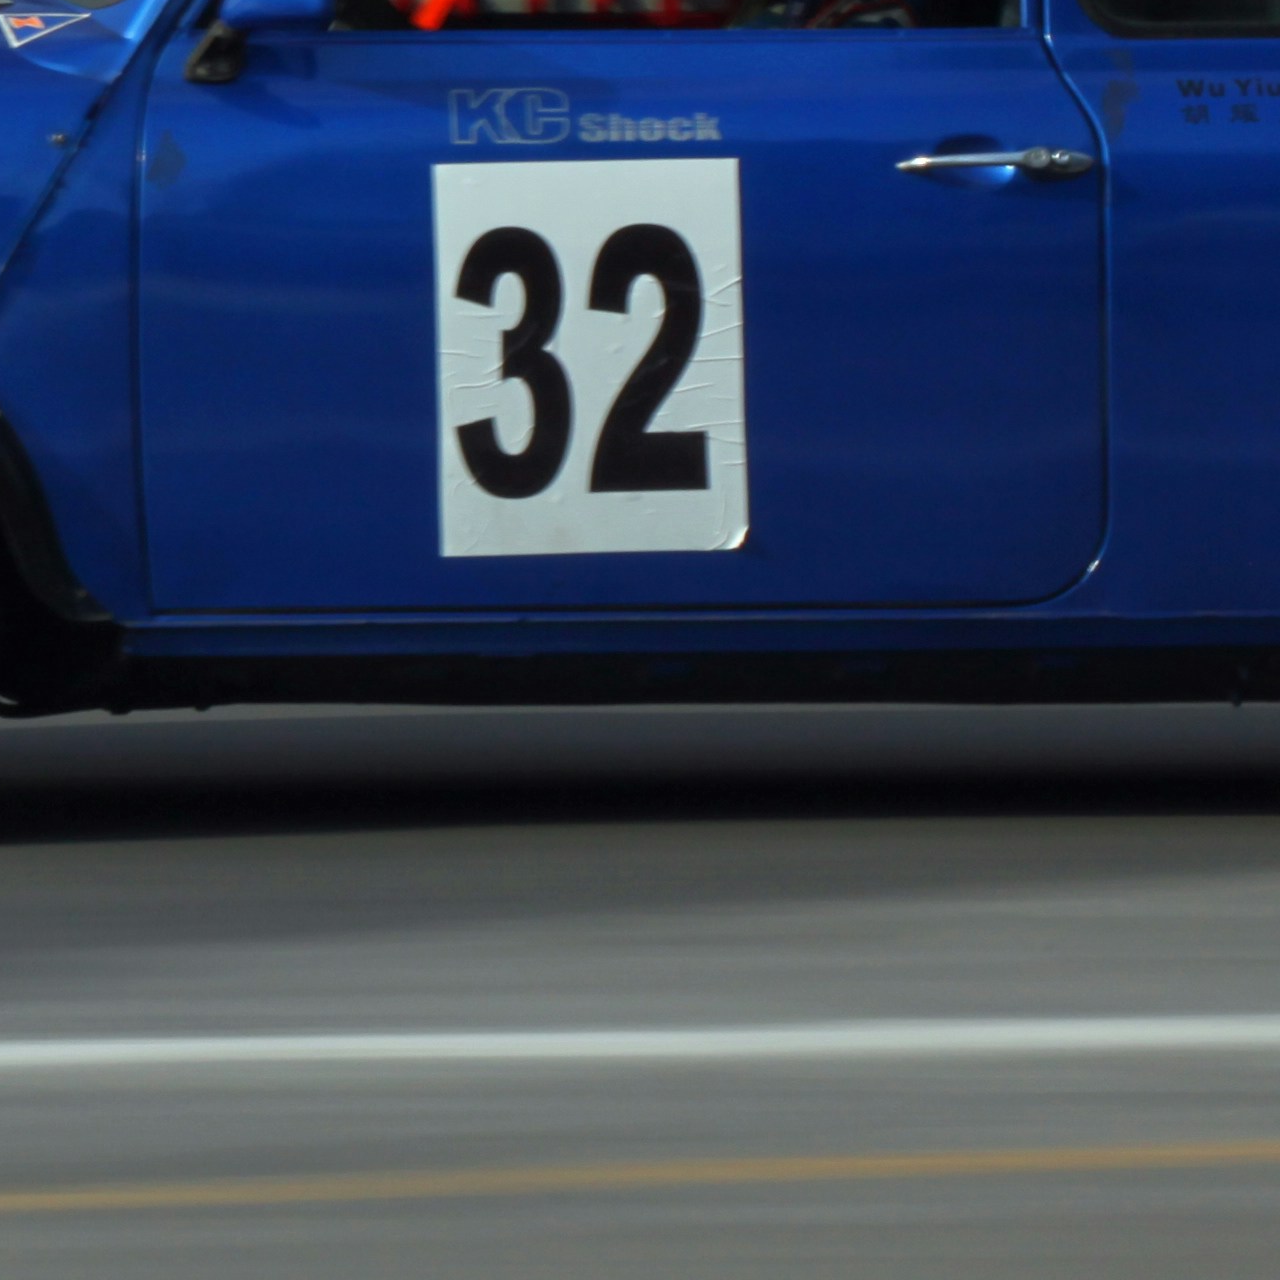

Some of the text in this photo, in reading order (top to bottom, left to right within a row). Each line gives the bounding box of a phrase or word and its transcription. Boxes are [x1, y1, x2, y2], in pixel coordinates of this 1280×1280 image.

[448, 87, 722, 145] KC Shock
[1176, 79, 1225, 97] Wu
[456, 223, 711, 499] 32
